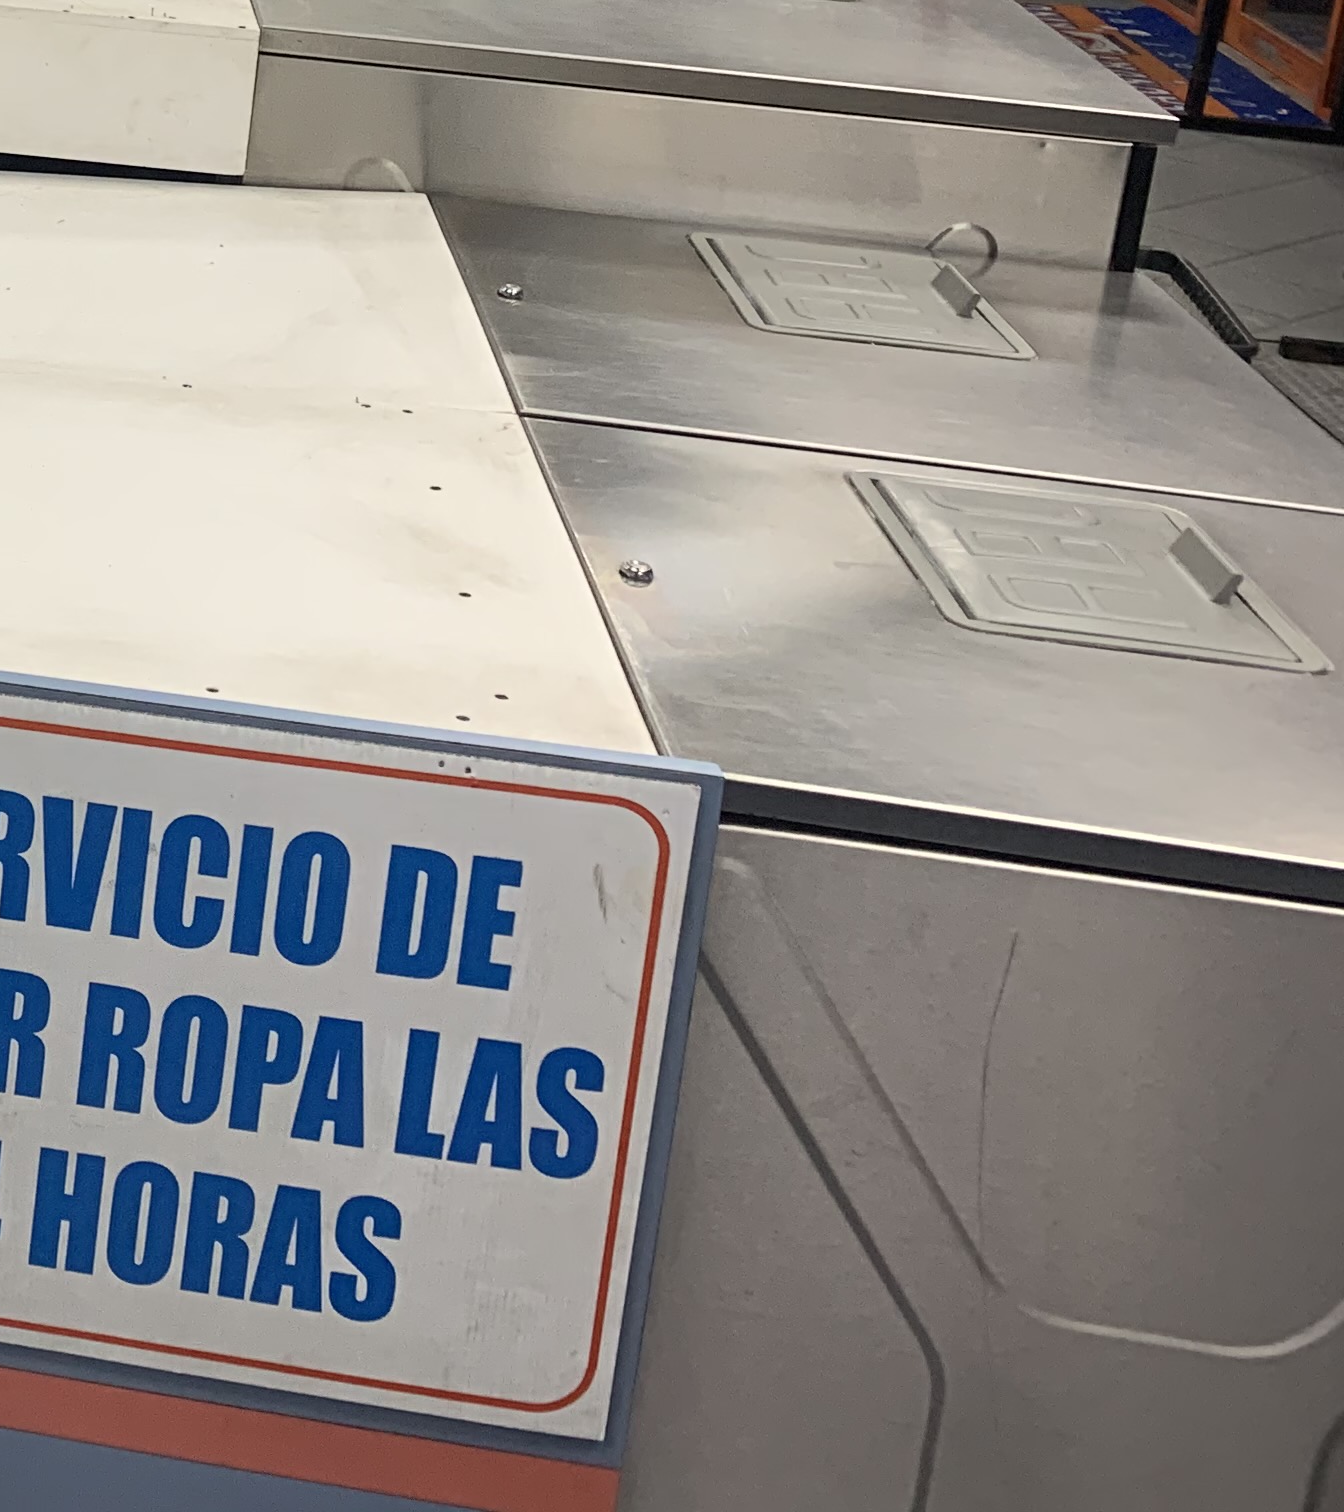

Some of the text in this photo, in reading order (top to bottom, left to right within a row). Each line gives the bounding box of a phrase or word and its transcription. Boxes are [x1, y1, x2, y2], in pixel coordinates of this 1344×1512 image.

[376, 844, 523, 991] DE
[76, 981, 364, 1148] ROPA
[393, 1029, 605, 1179] LAS
[28, 1147, 402, 1323] HORAS
